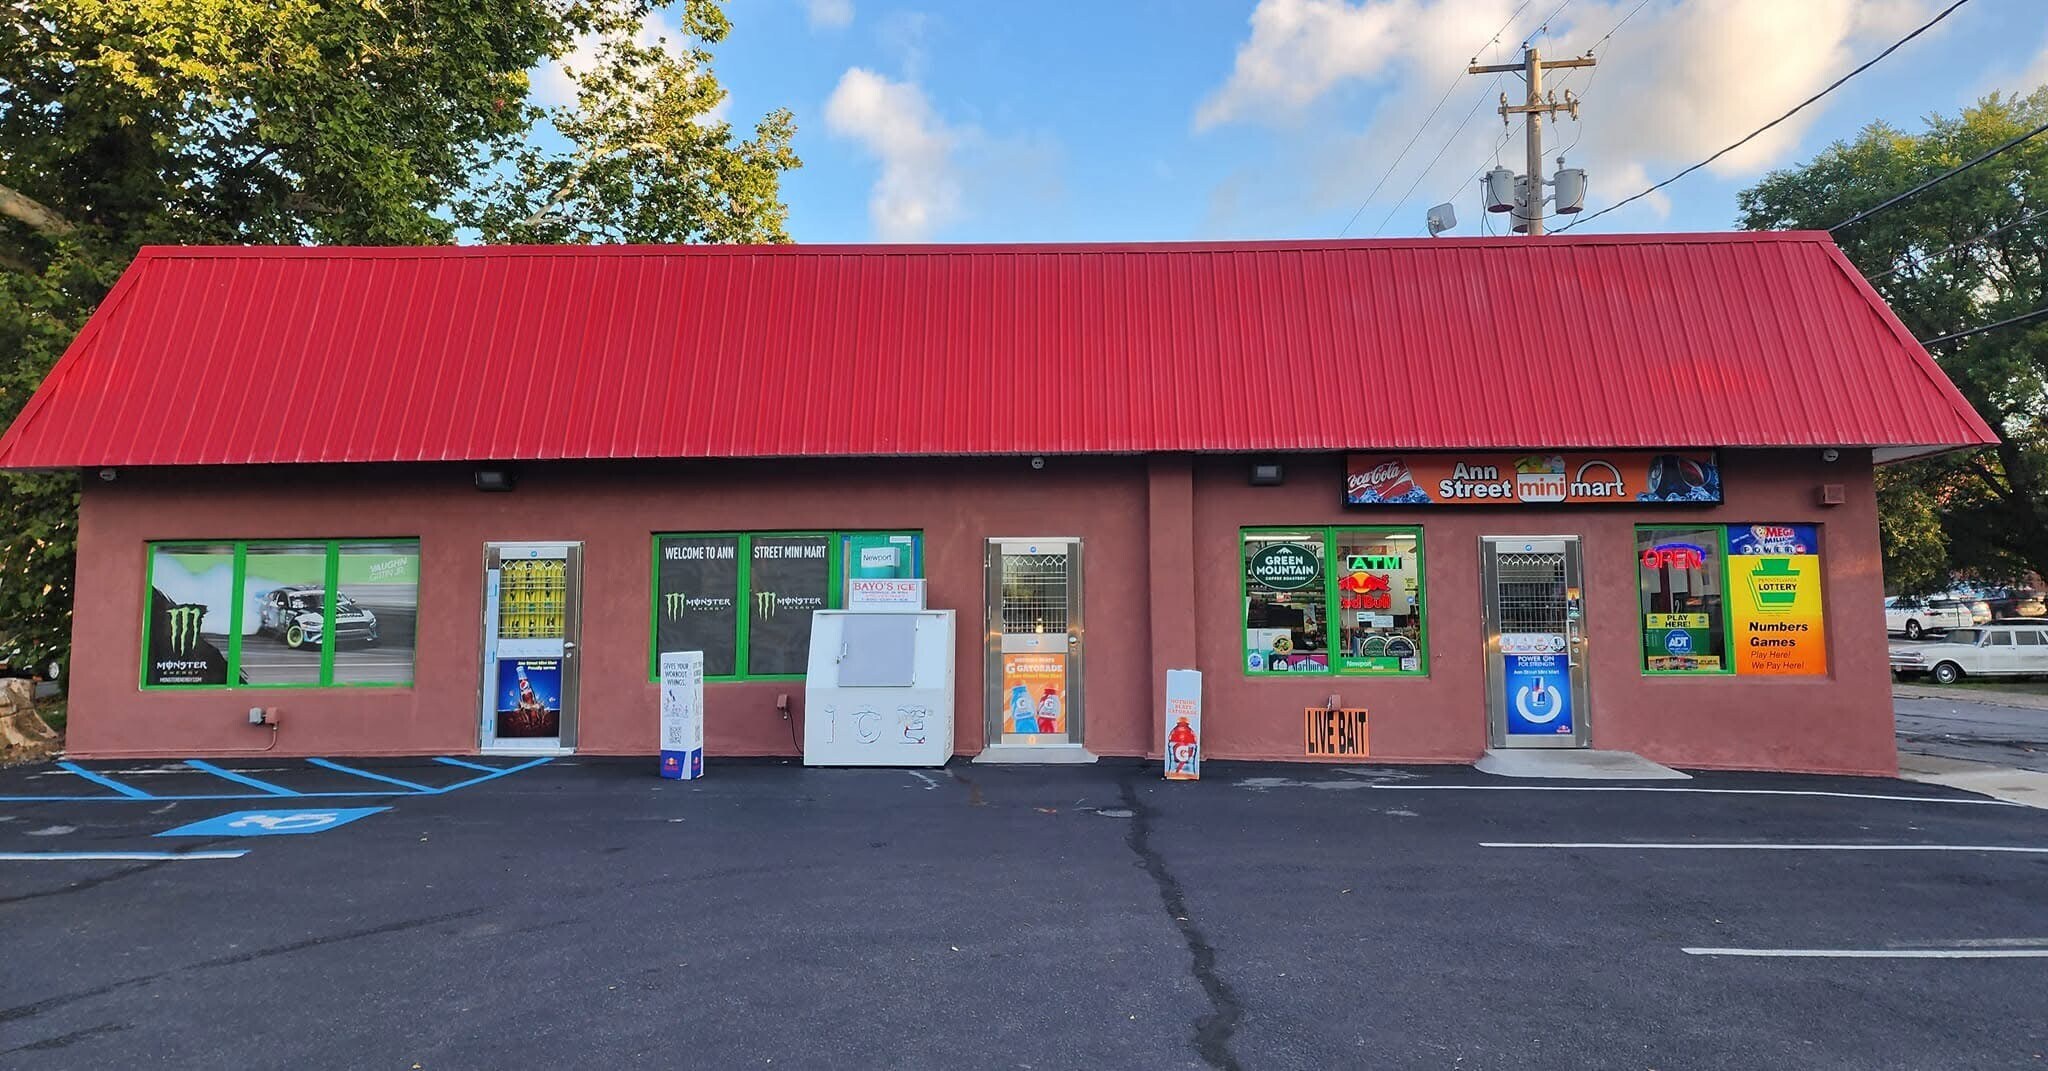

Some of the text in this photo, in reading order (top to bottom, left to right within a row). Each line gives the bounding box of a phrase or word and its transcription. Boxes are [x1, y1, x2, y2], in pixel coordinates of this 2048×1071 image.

[1454, 463, 1497, 480] Ann
[1439, 477, 1625, 499] Street mini mart
[665, 546, 734, 560] WELCOME TO ANN
[754, 545, 826, 559] STREET MINI MART
[863, 554, 892, 562] Newport
[1265, 556, 1303, 565] GREEN
[1643, 549, 1703, 569] OPEN
[1351, 557, 1400, 570] ATM
[1256, 566, 1314, 575] MOUNTAIN
[854, 582, 915, 591] BAYO'S ICE
[1758, 583, 1797, 591] LOTTERY
[686, 598, 731, 607] MONSTER
[777, 597, 822, 606] MONSTER
[1363, 593, 1391, 609] Bull
[1749, 621, 1808, 632] Numbers
[1668, 637, 1689, 647] ADT
[1750, 637, 1796, 647] Games
[1751, 650, 1791, 660] Play Here!
[157, 660, 207, 670] MONSTER
[1017, 664, 1063, 672] GATORADE
[1766, 662, 1781, 670] Pay
[1782, 661, 1805, 669] Here!
[1307, 710, 1366, 755] LIVE BAIT
